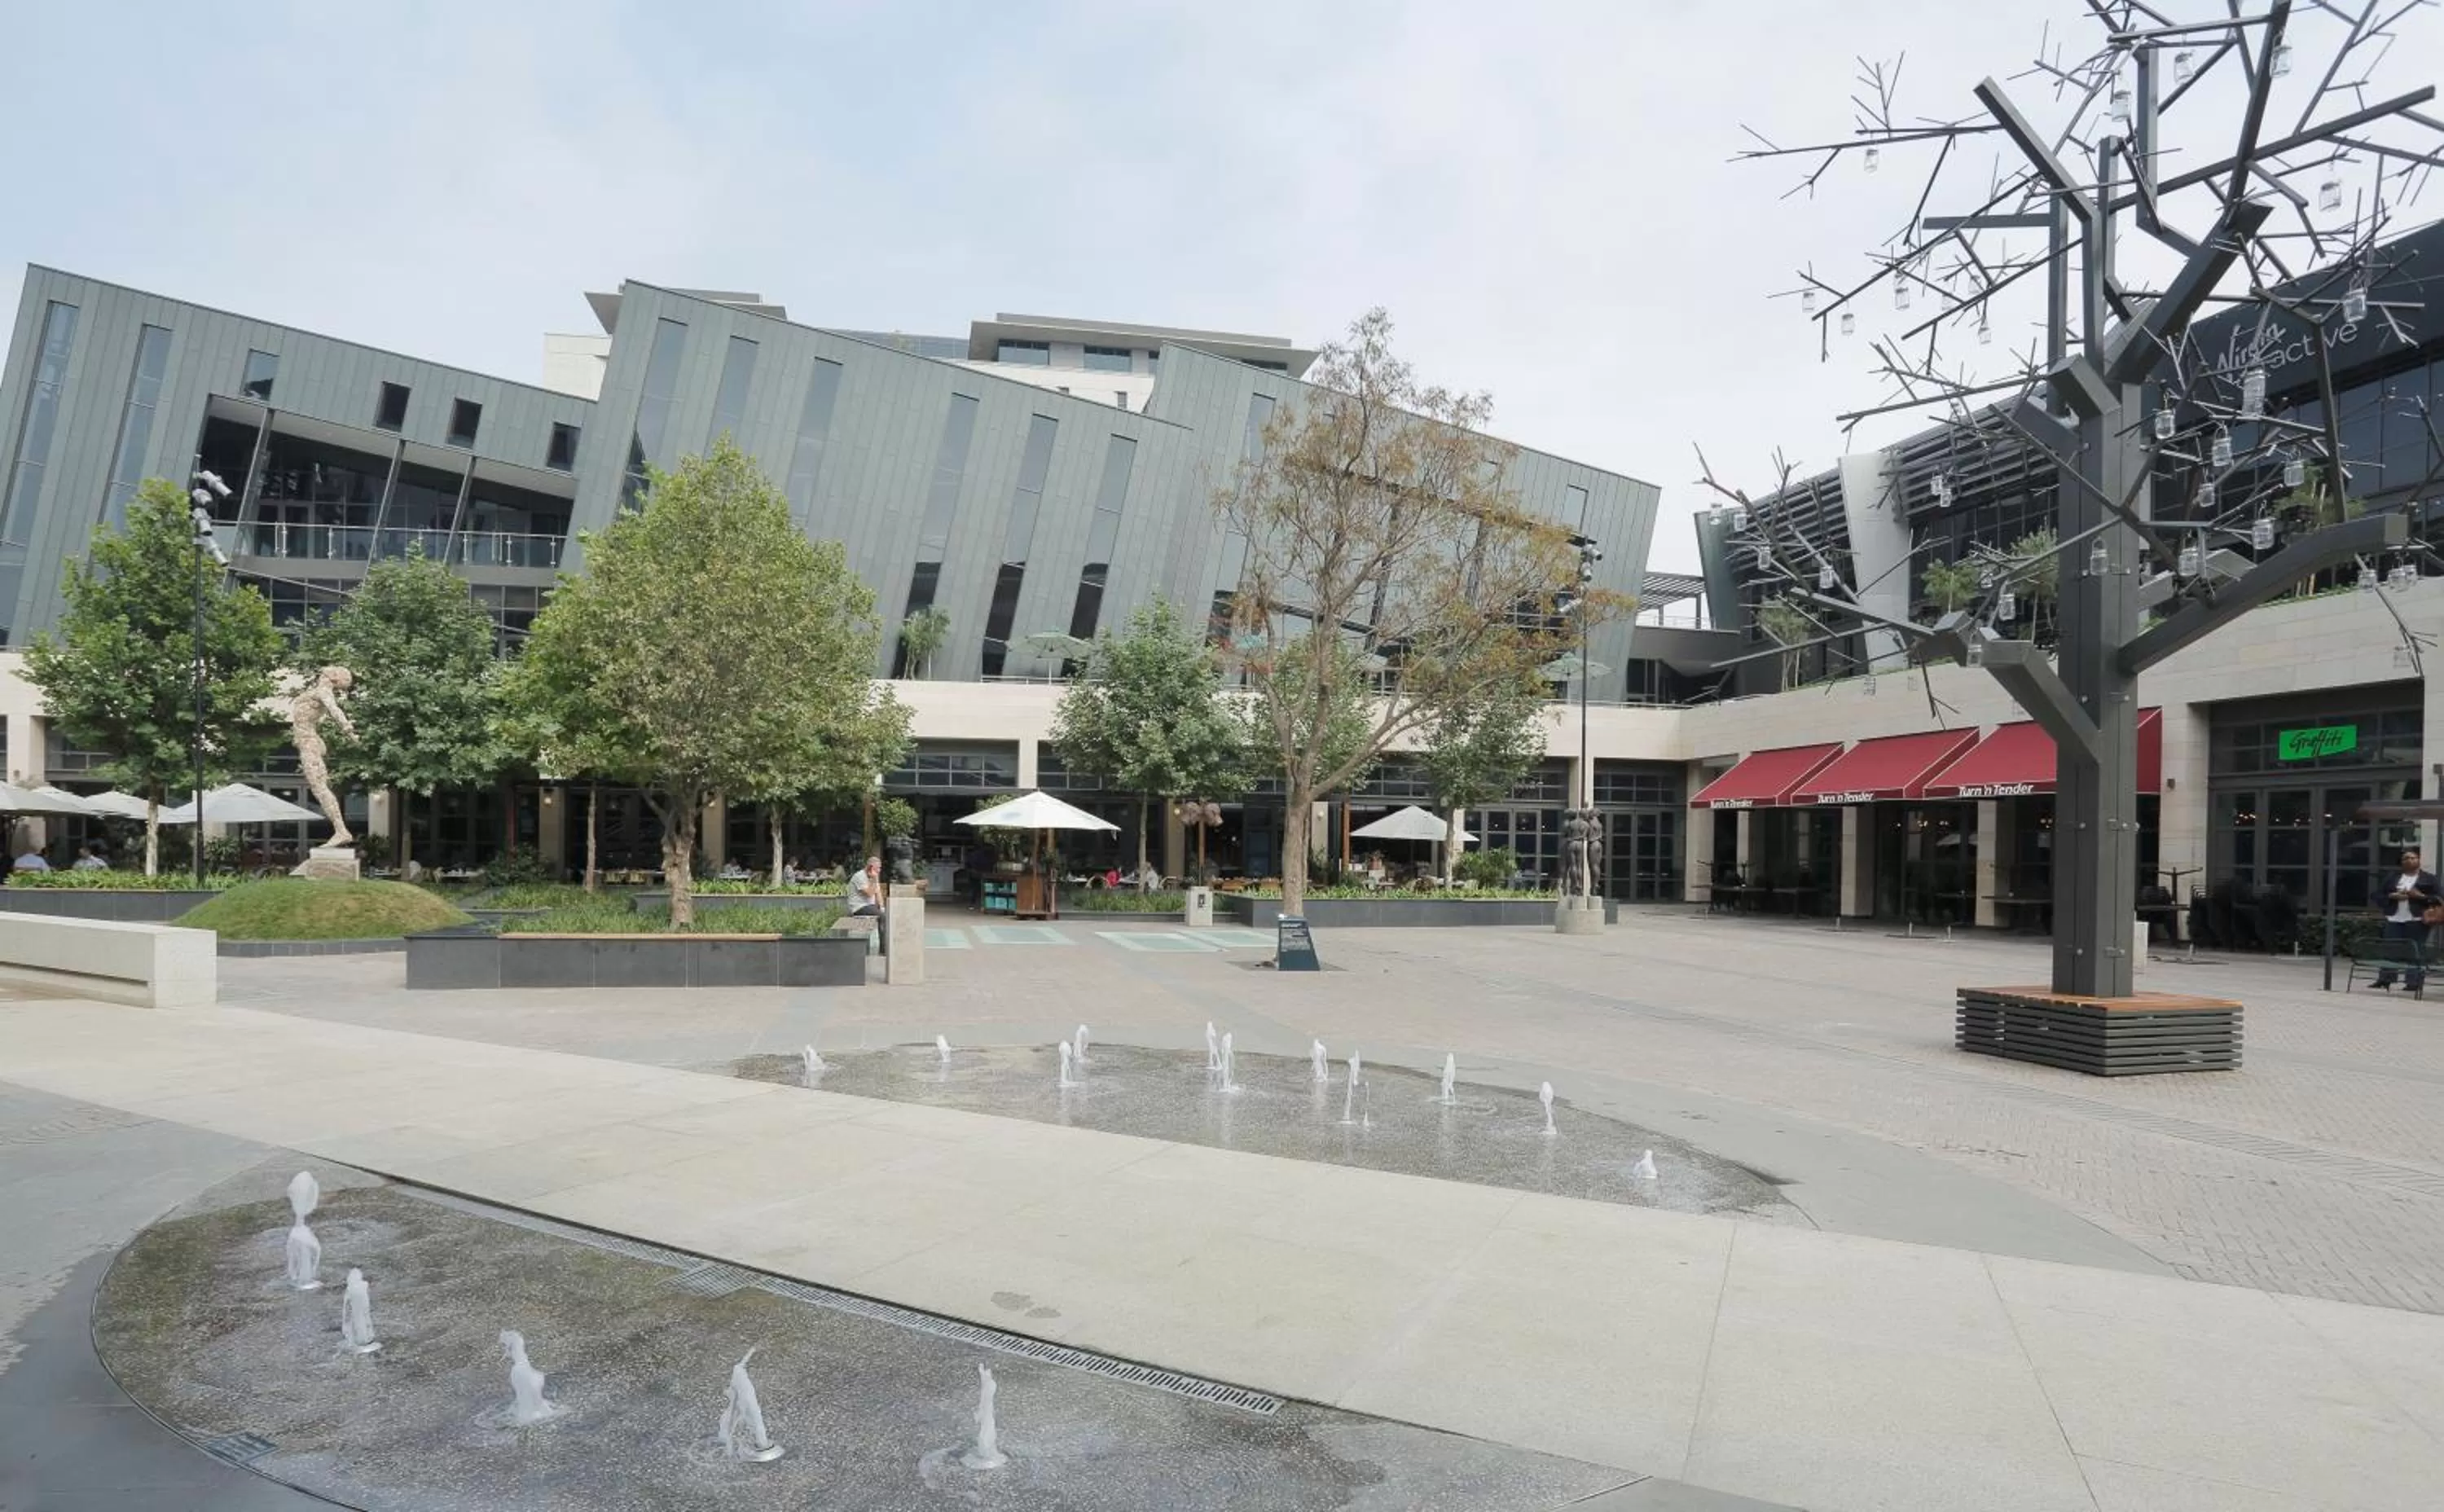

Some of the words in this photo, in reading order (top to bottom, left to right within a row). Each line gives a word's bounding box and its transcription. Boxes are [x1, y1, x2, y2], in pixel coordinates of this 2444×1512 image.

[2268, 323, 2358, 369] actve
[2289, 729, 2345, 757] Graffiti
[1958, 786, 1981, 798] Turn
[1993, 783, 2034, 796] Tender
